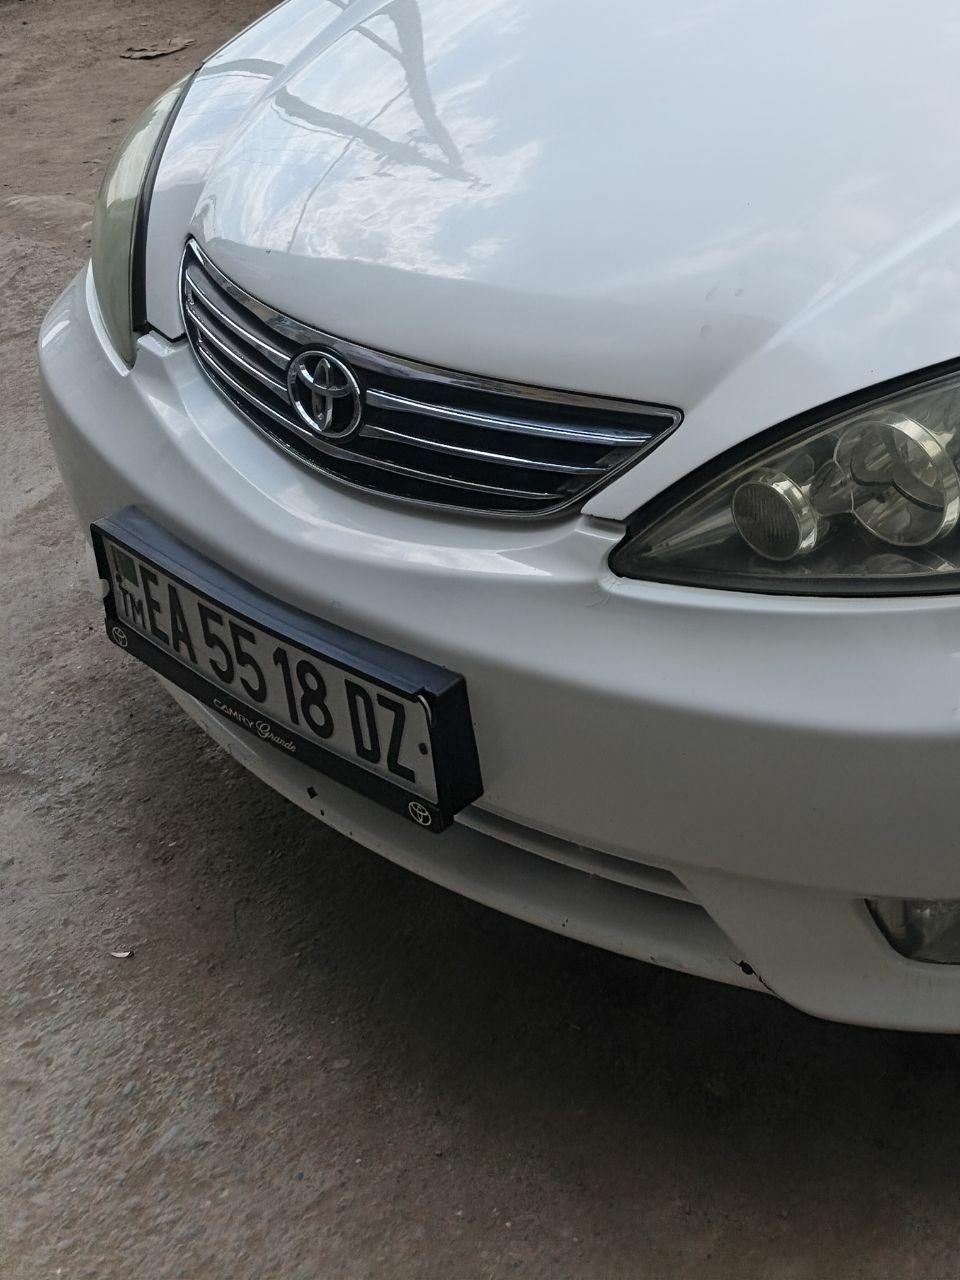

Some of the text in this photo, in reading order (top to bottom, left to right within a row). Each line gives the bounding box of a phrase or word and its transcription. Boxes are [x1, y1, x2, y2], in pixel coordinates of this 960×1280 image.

[139, 564, 198, 664] EA
[344, 678, 416, 784] DZ
[213, 698, 297, 752] CAMRY Grande
